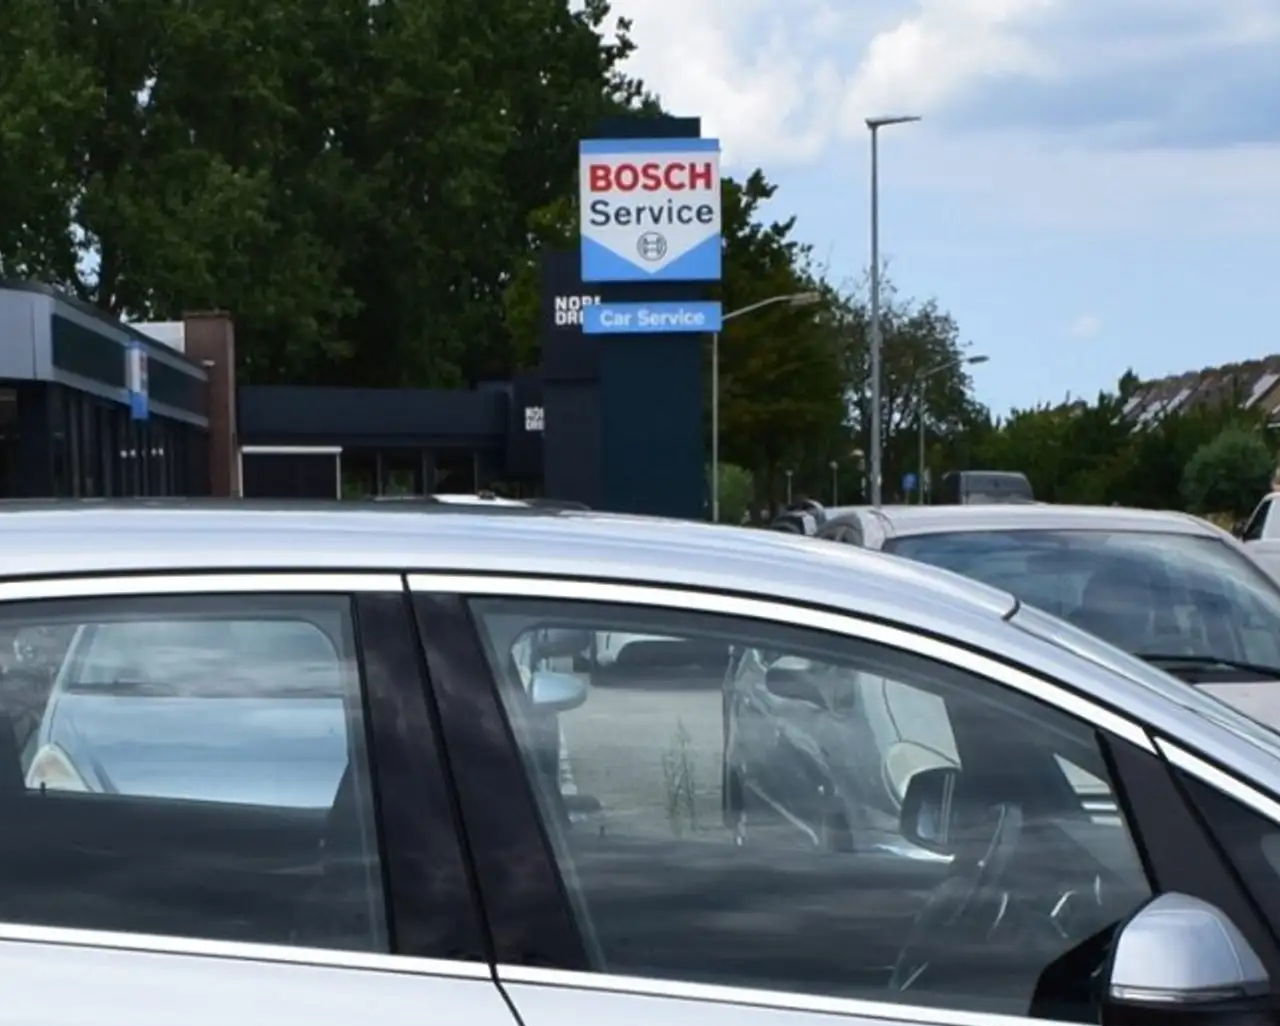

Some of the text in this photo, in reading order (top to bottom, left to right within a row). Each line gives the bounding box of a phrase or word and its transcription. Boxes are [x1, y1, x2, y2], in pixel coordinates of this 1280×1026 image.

[589, 162, 712, 192] BOSCH
[589, 199, 714, 226] Service
[599, 309, 705, 327] Car Service
